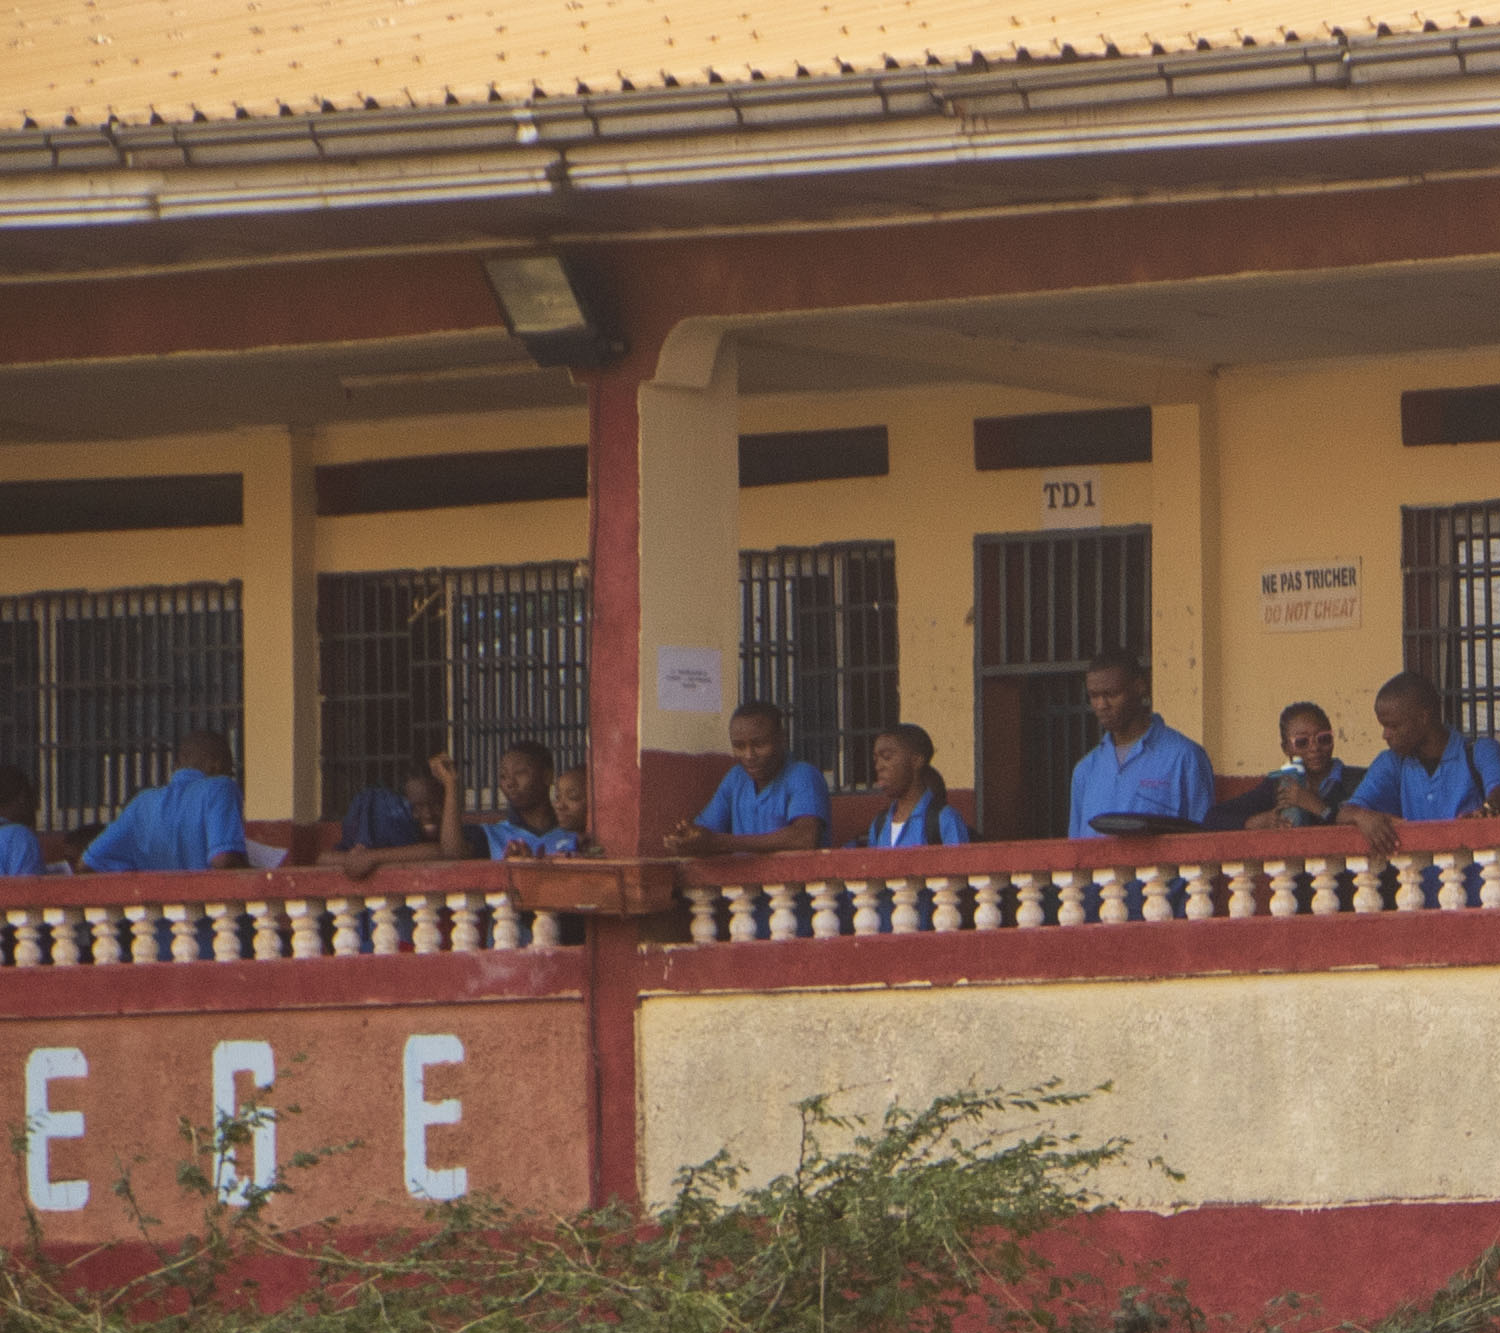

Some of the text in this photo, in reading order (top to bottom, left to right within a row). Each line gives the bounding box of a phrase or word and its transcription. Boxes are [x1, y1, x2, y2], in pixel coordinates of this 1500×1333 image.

[1043, 480, 1096, 509] TD1
[1262, 566, 1357, 594] NE PAS TRICHER
[1264, 597, 1357, 623] DO NOT CHEAT
